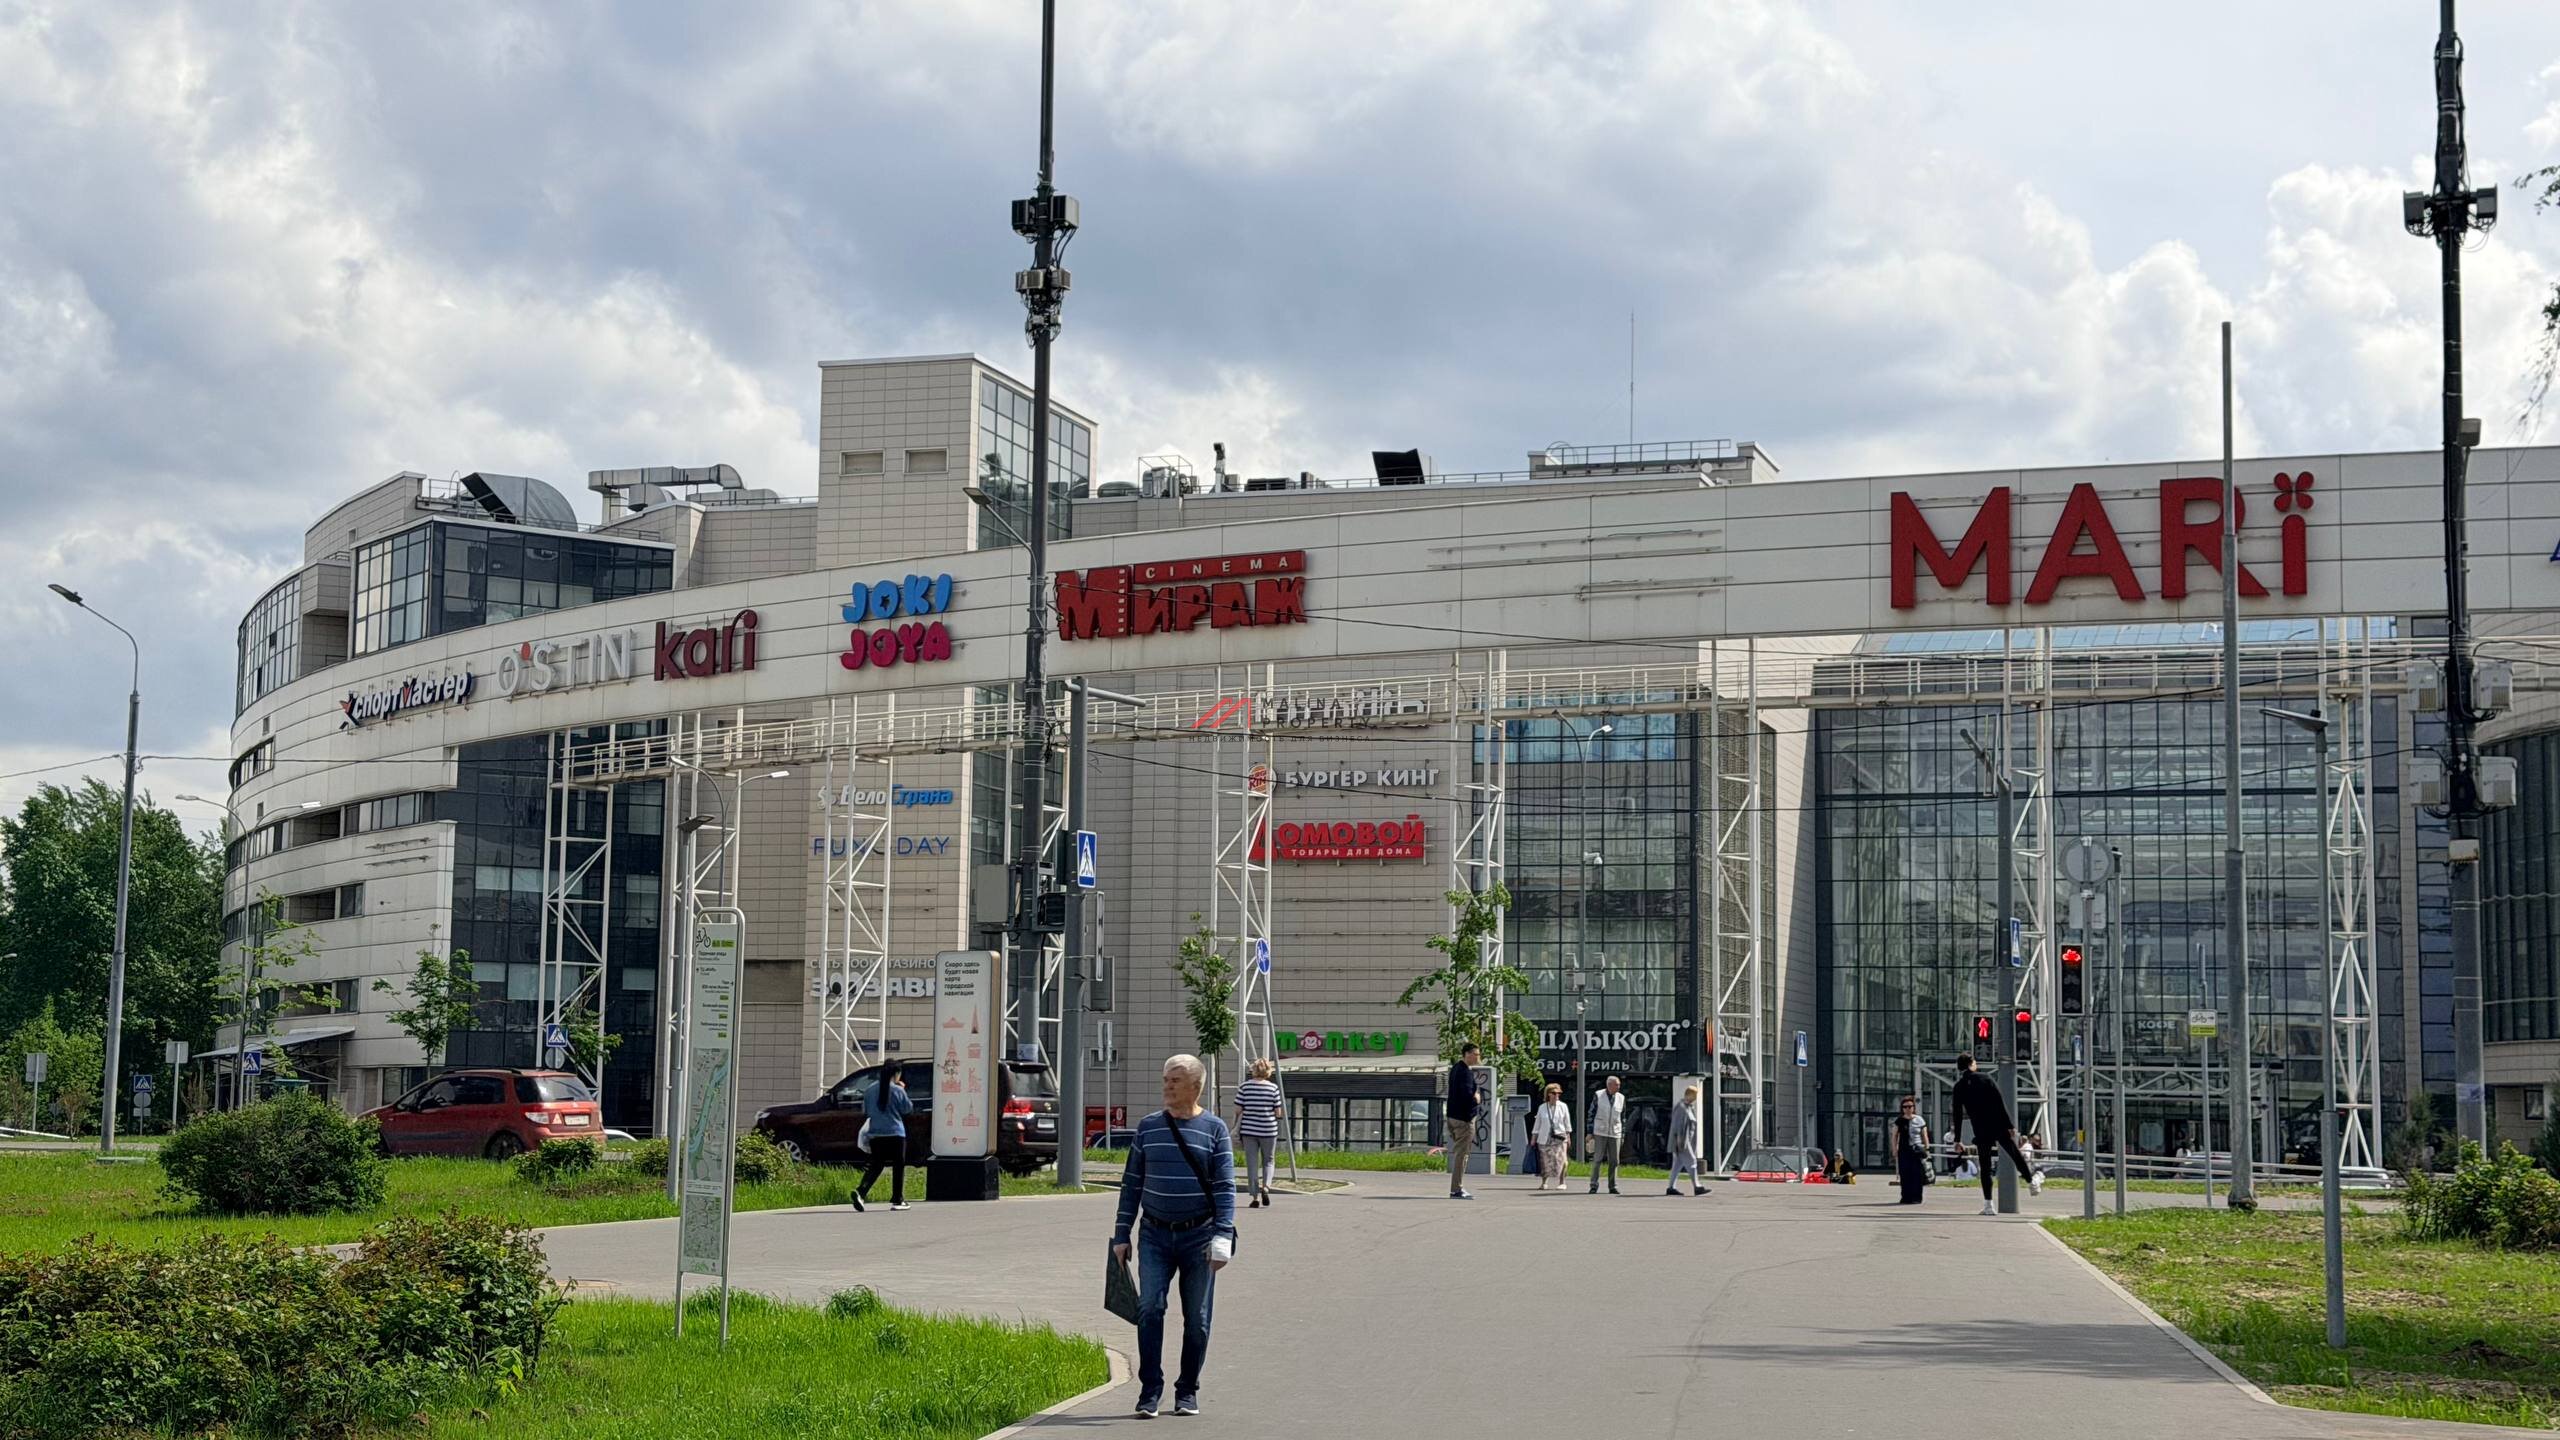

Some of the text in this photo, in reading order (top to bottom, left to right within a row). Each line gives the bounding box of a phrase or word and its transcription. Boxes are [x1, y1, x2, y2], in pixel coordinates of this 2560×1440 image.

[1146, 557, 1288, 579] CINEMA
[842, 573, 953, 624] JOKI
[654, 609, 758, 681] kari
[840, 621, 952, 670] JOYA
[1285, 770, 1368, 788] БУРГЕР
[1377, 768, 1439, 787] КИНГ
[813, 837, 950, 856] FUN DAY
[1346, 848, 1370, 856] ДЛЯ
[1377, 847, 1412, 856] ДОМА
[1536, 1058, 1566, 1072] бар
